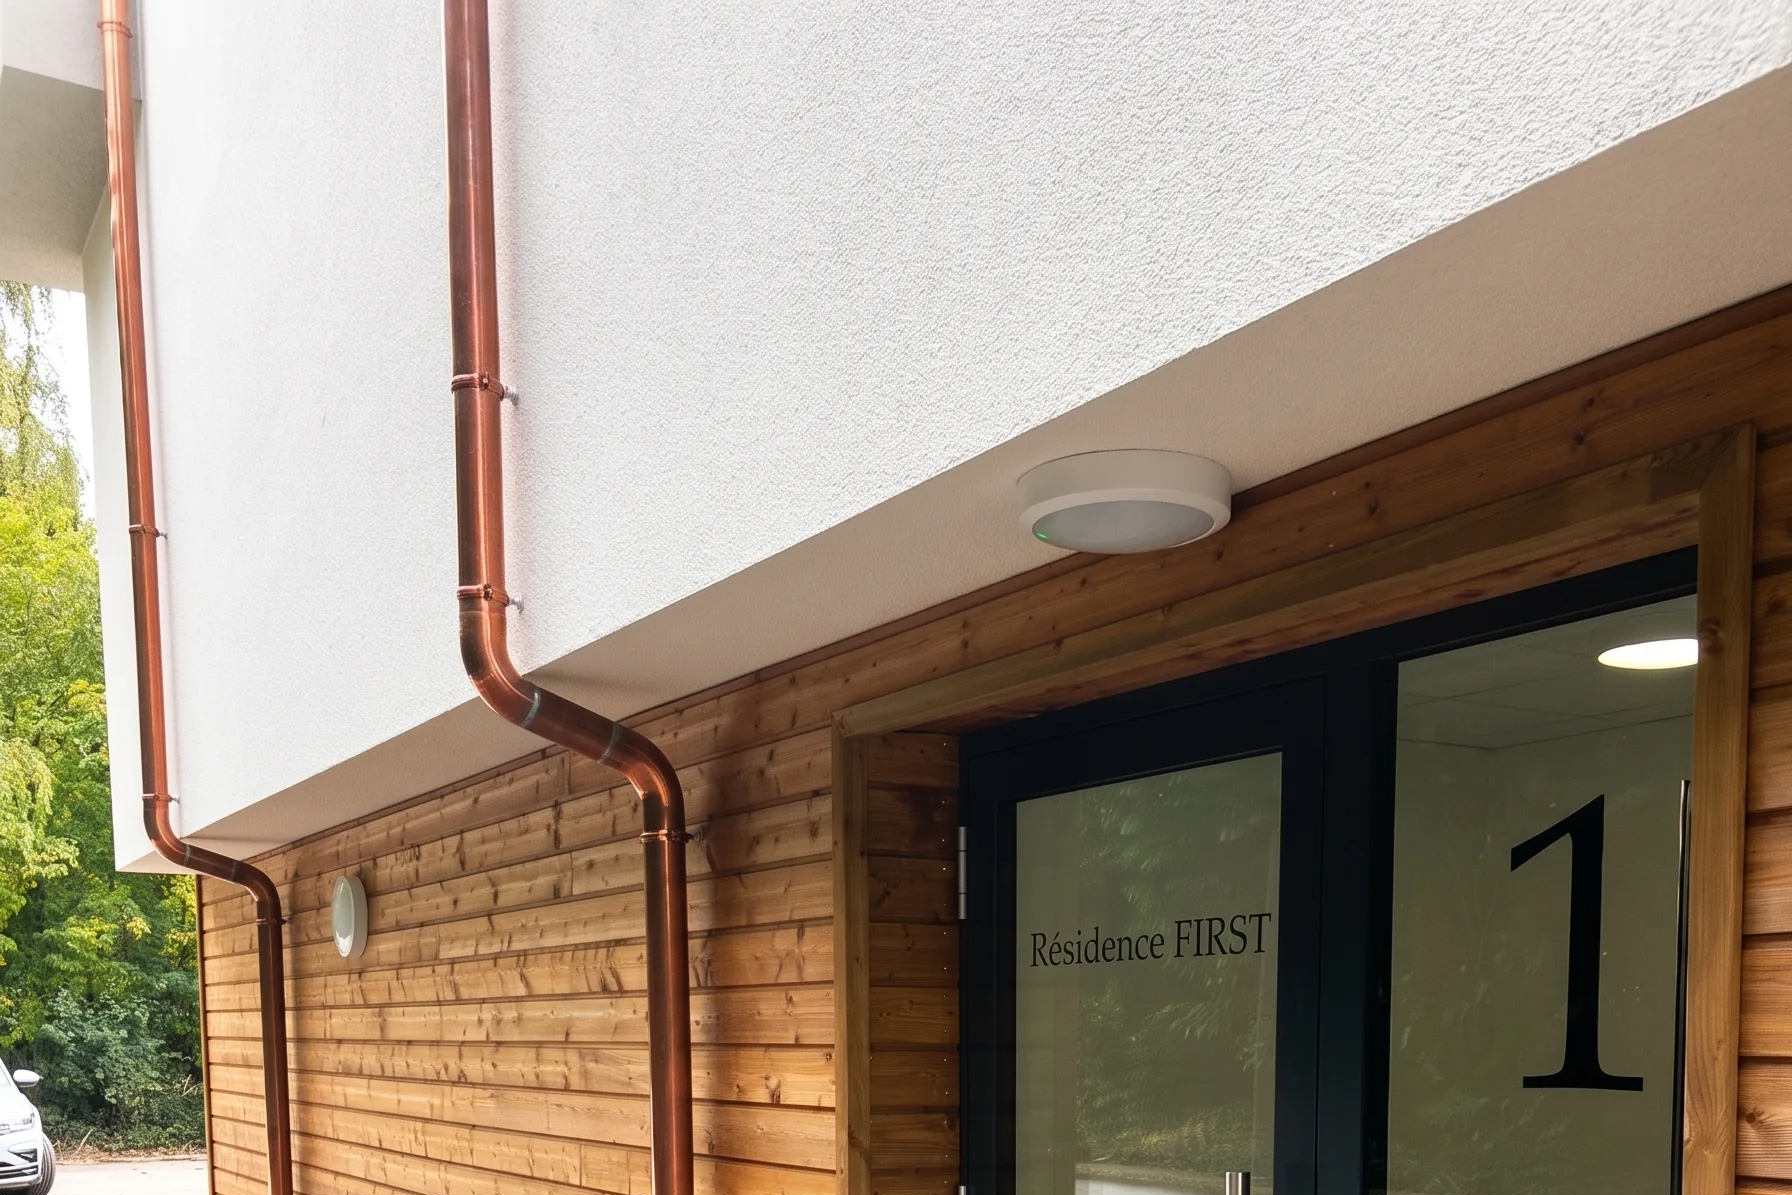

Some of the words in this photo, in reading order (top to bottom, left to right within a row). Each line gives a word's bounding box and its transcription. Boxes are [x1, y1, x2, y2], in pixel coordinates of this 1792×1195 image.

[1030, 926, 1165, 967] Résidence
[1173, 913, 1271, 958] FIRST
[1511, 794, 1643, 1092] 1
